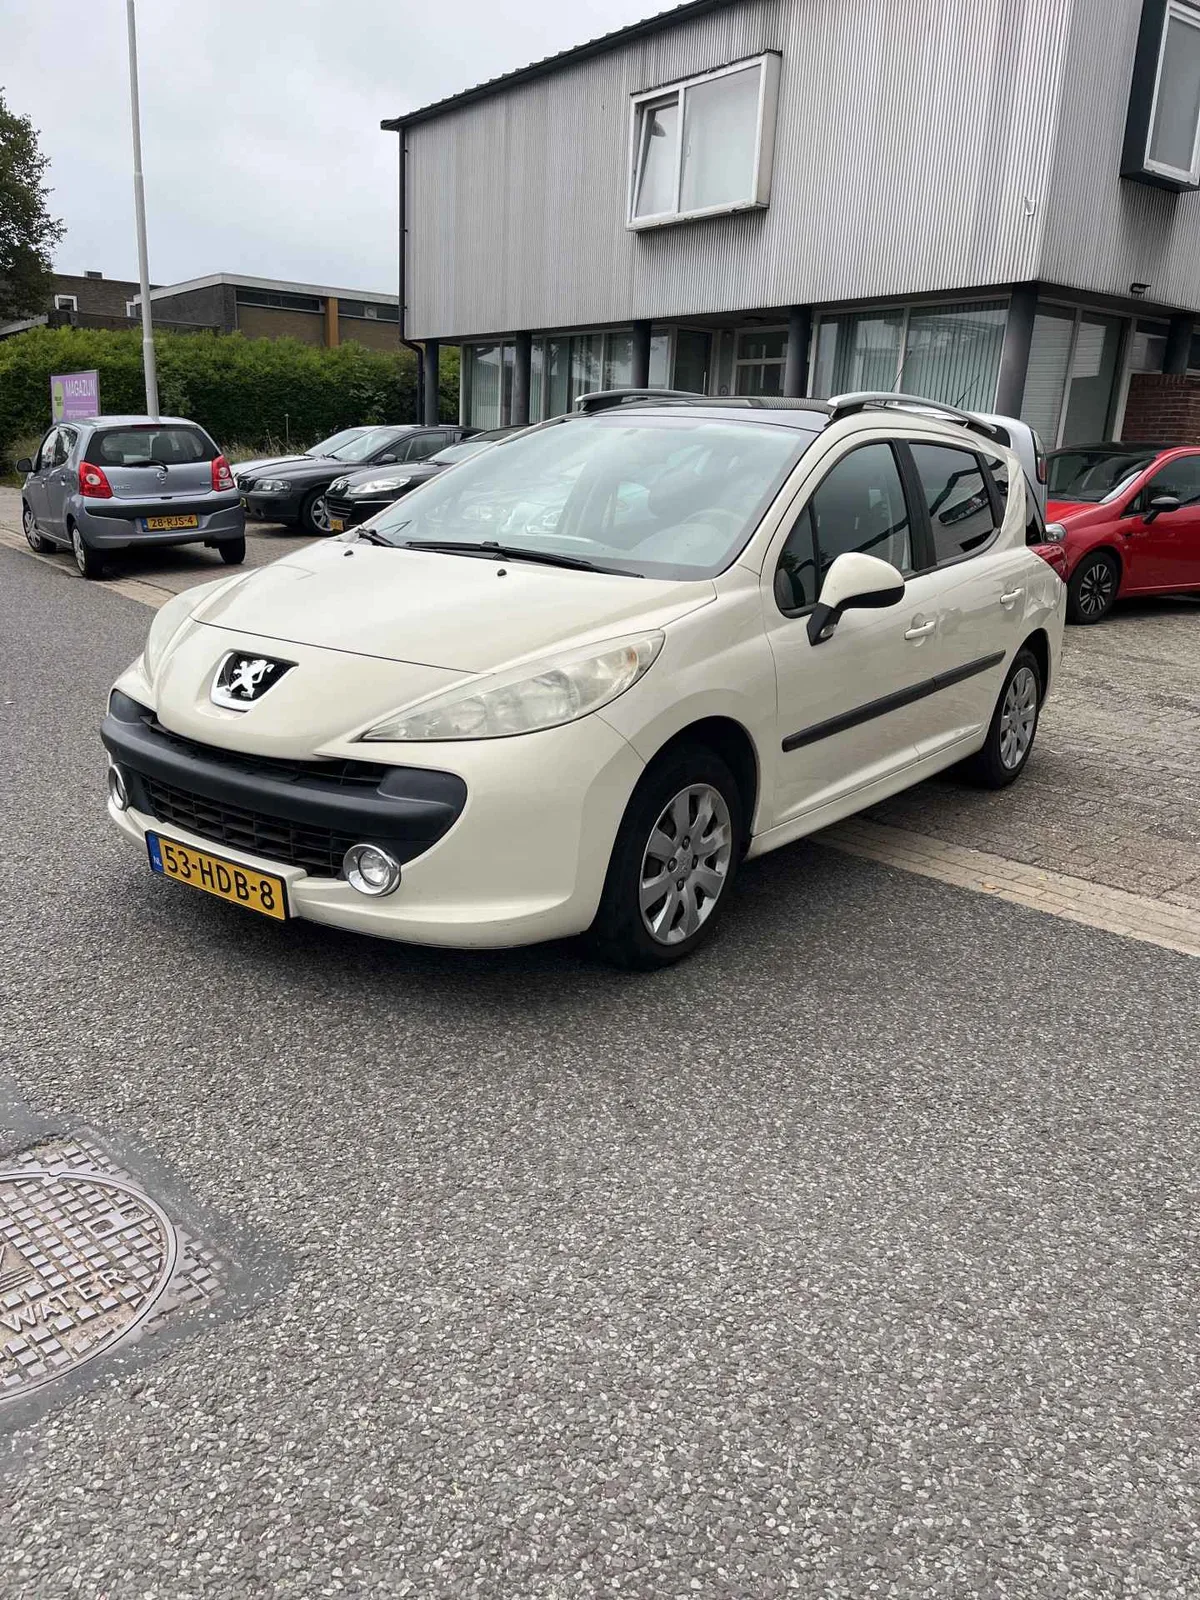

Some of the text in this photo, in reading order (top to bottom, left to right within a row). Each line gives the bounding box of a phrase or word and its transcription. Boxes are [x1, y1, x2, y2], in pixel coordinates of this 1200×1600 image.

[151, 516, 194, 528] 28-RJS-4
[164, 844, 275, 911] 53-HDB-8
[1, 1268, 127, 1333] WATER
